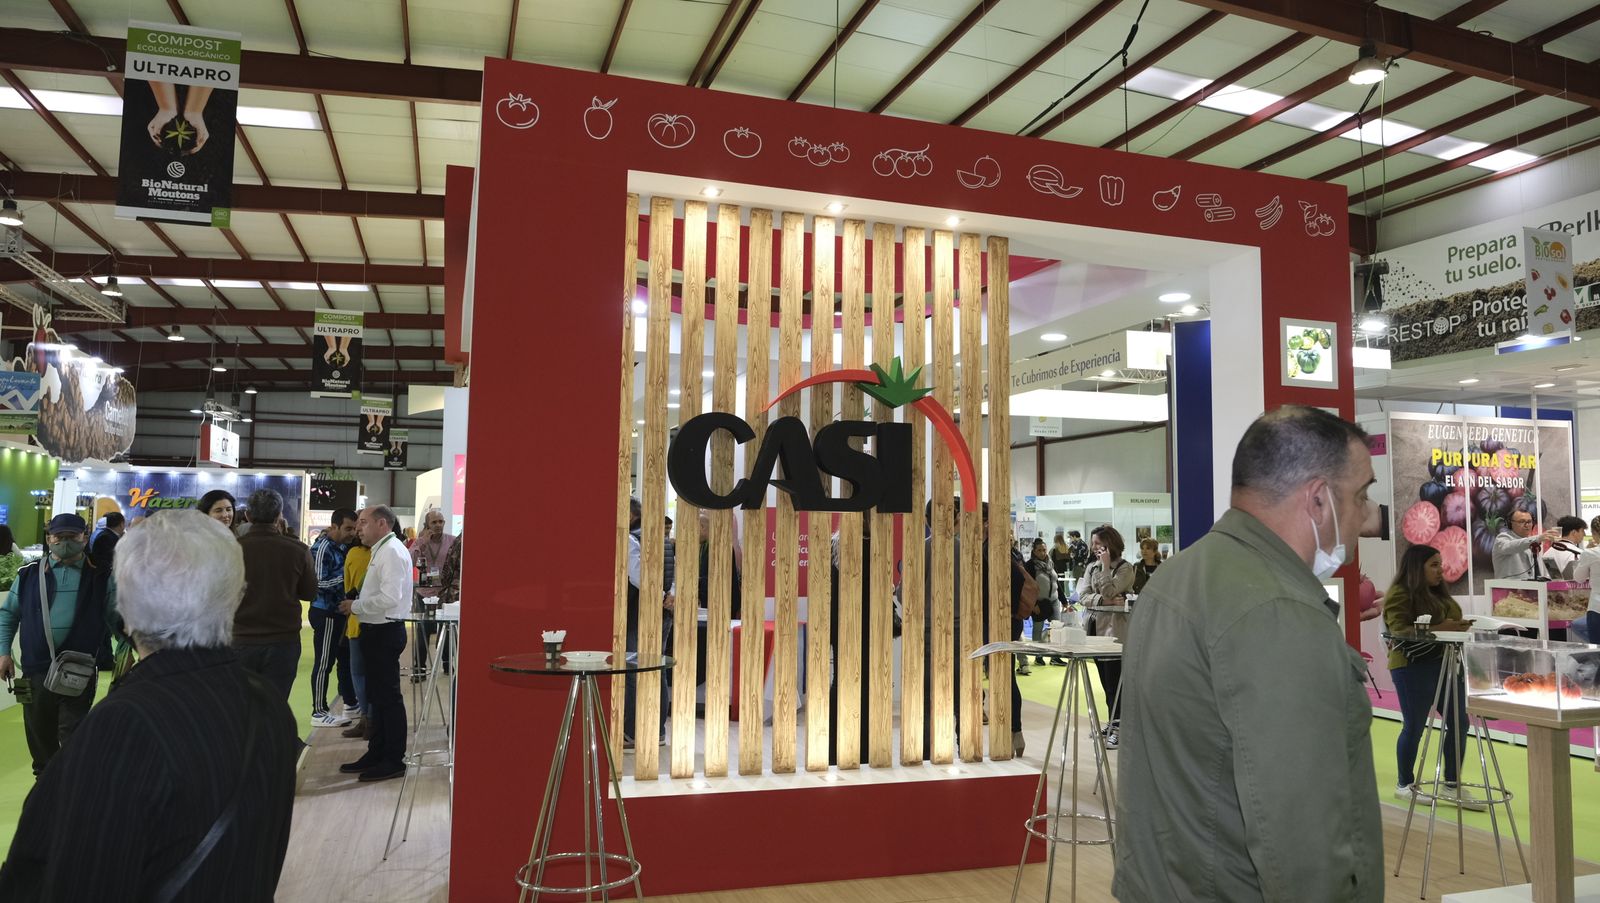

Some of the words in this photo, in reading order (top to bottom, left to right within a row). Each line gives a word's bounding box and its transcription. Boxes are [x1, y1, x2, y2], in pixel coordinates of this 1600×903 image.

[147, 32, 222, 51] COMPOST
[133, 59, 231, 82] ULTRAPRO
[142, 179, 208, 192] BioNatural
[148, 187, 200, 200] Moutons
[1447, 234, 1517, 264] Prepara
[1445, 268, 1463, 284] tu
[1467, 254, 1521, 280] suelo.
[322, 313, 355, 321] COMPOST
[1477, 321, 1496, 337] tu
[1502, 310, 1528, 334] raí
[317, 326, 360, 335] ULTRAPRO
[1011, 375, 1021, 388] Te
[1021, 367, 1057, 386] Cubrimos
[1058, 364, 1069, 377] de
[1070, 348, 1121, 376] Experiencia
[667, 411, 913, 513] CASI
[1503, 453, 1537, 470] STAR
[1445, 475, 1456, 487] EL
[1458, 476, 1476, 488] AN
[1478, 476, 1494, 488] DEL
[1496, 477, 1525, 489] SABOR
